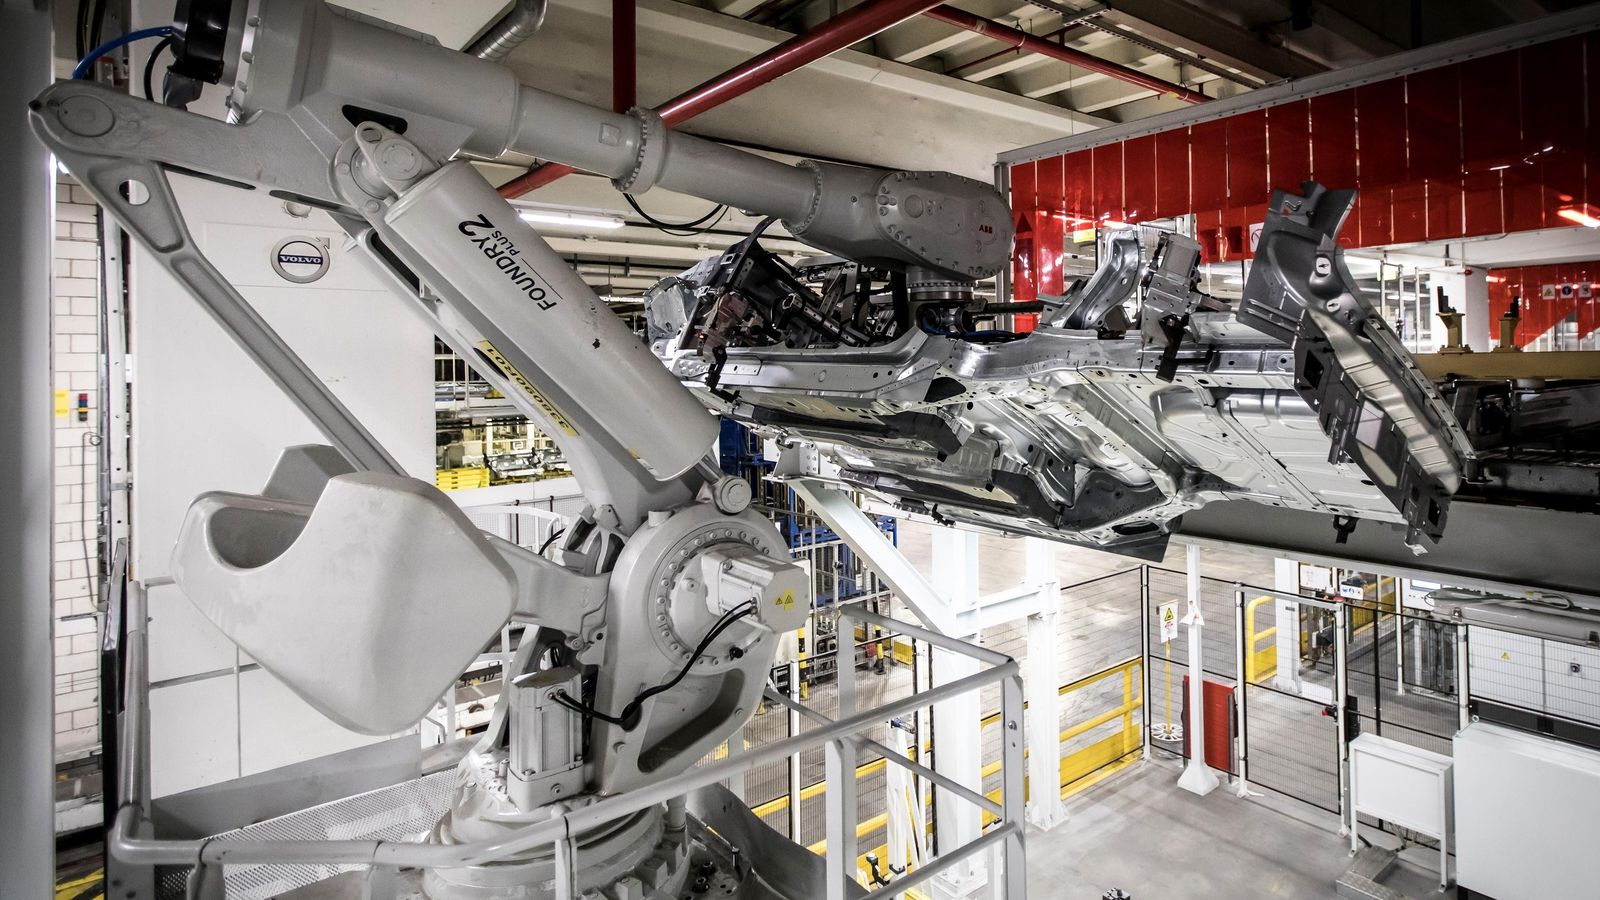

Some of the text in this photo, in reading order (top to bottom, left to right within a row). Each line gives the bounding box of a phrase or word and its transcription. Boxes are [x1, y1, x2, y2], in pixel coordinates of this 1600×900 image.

[979, 224, 993, 234] ABB
[491, 230, 520, 256] PLUS
[279, 255, 321, 264] VOLVO
